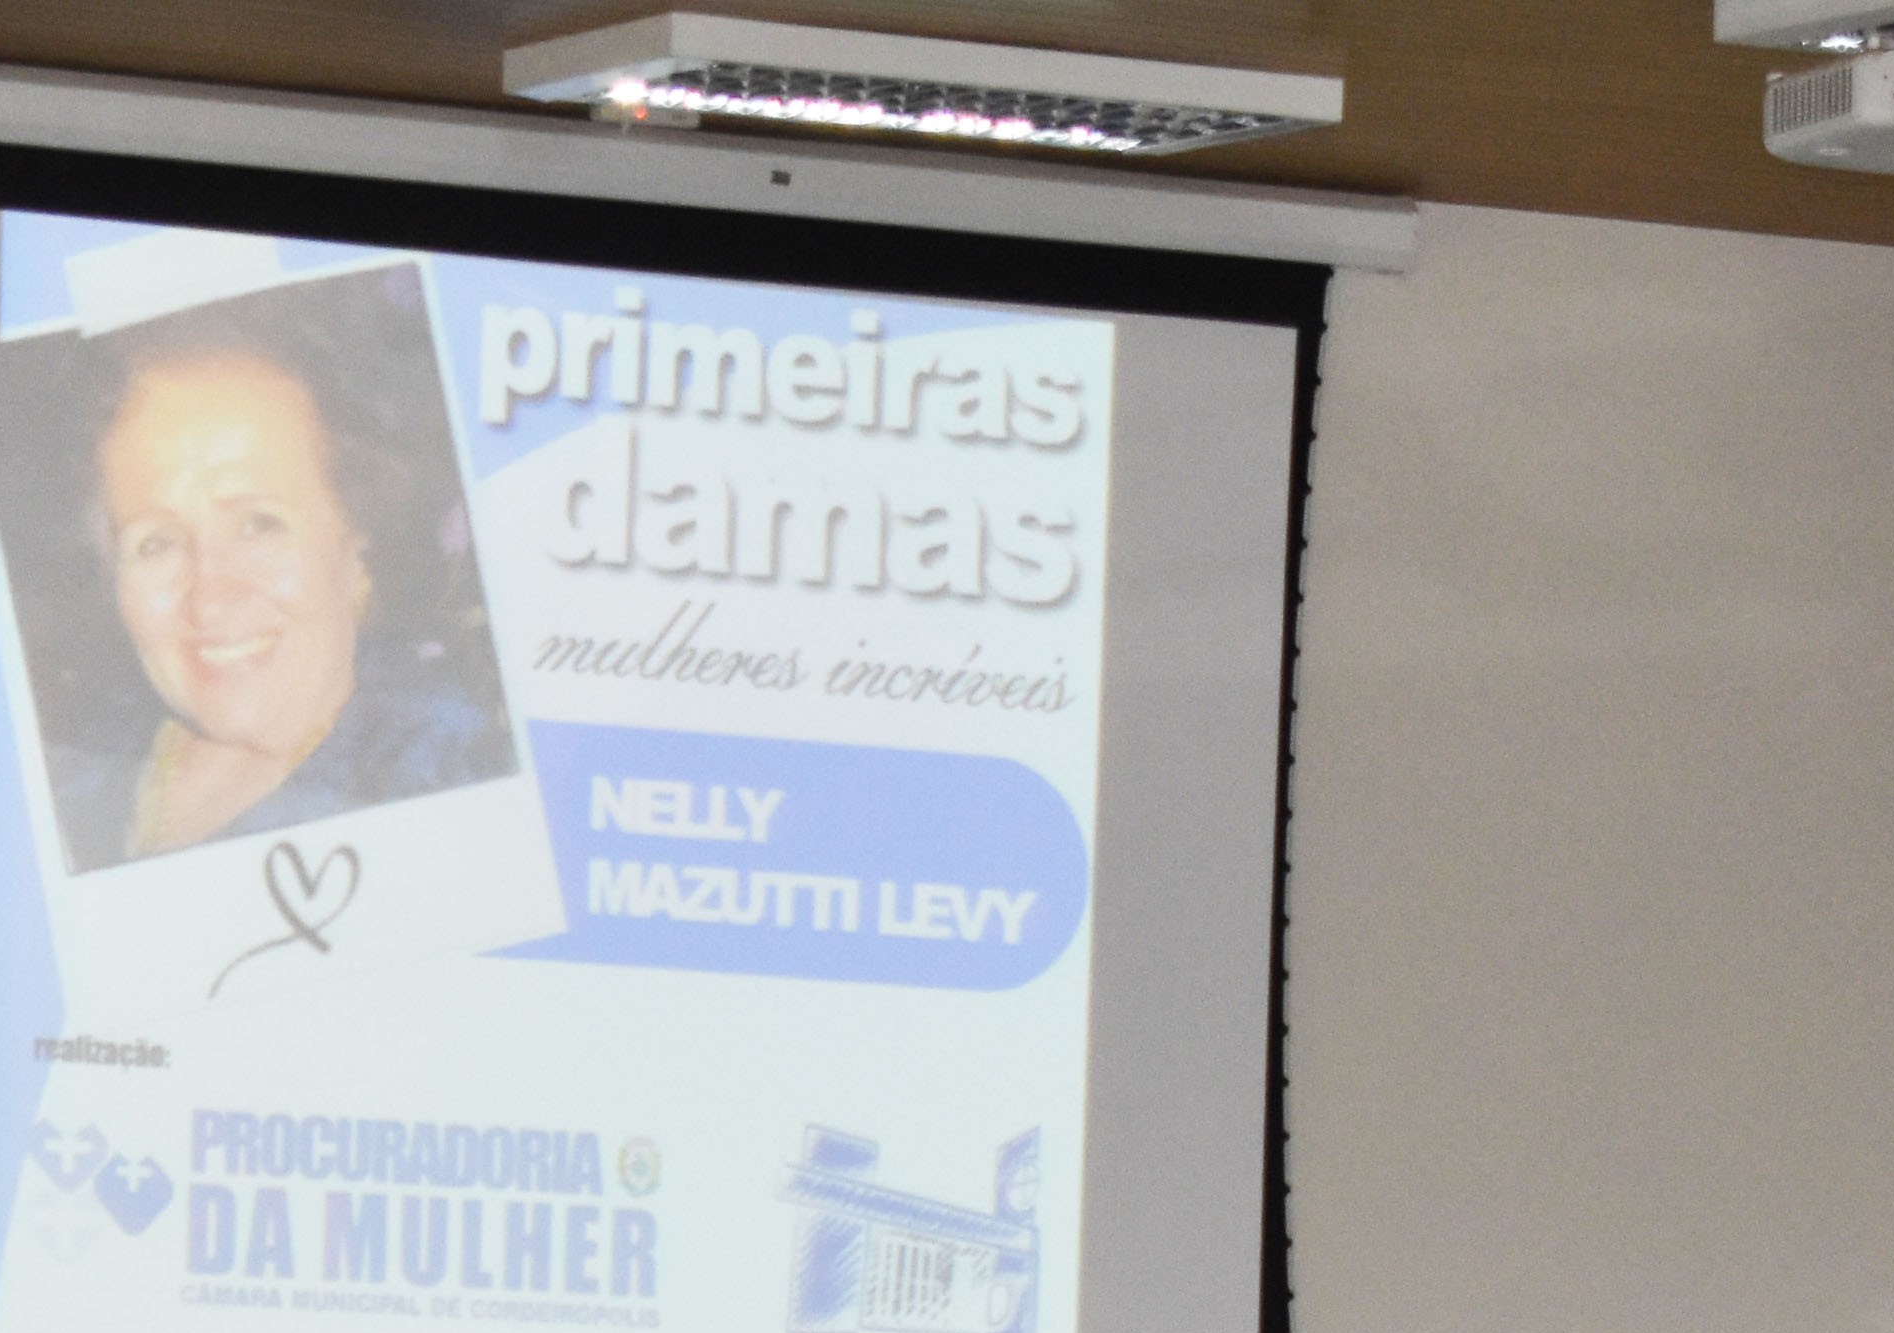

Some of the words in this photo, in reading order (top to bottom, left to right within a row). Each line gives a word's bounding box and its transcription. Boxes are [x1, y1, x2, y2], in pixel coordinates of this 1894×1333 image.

[479, 285, 1087, 453] primeiras
[544, 415, 1083, 610] damas
[534, 600, 811, 690] mulheres
[824, 640, 1077, 714] incríveis
[589, 774, 786, 844] NELLY
[587, 858, 861, 934] MAZUTTI
[877, 879, 1040, 947] LEVY
[33, 1034, 171, 1071] realização:
[189, 1107, 605, 1196] PROCURADORIA
[186, 1182, 295, 1280] DA
[321, 1190, 659, 1298] MULHER
[292, 1290, 422, 1317] MUNICIPAL
[429, 1297, 462, 1320] DE
